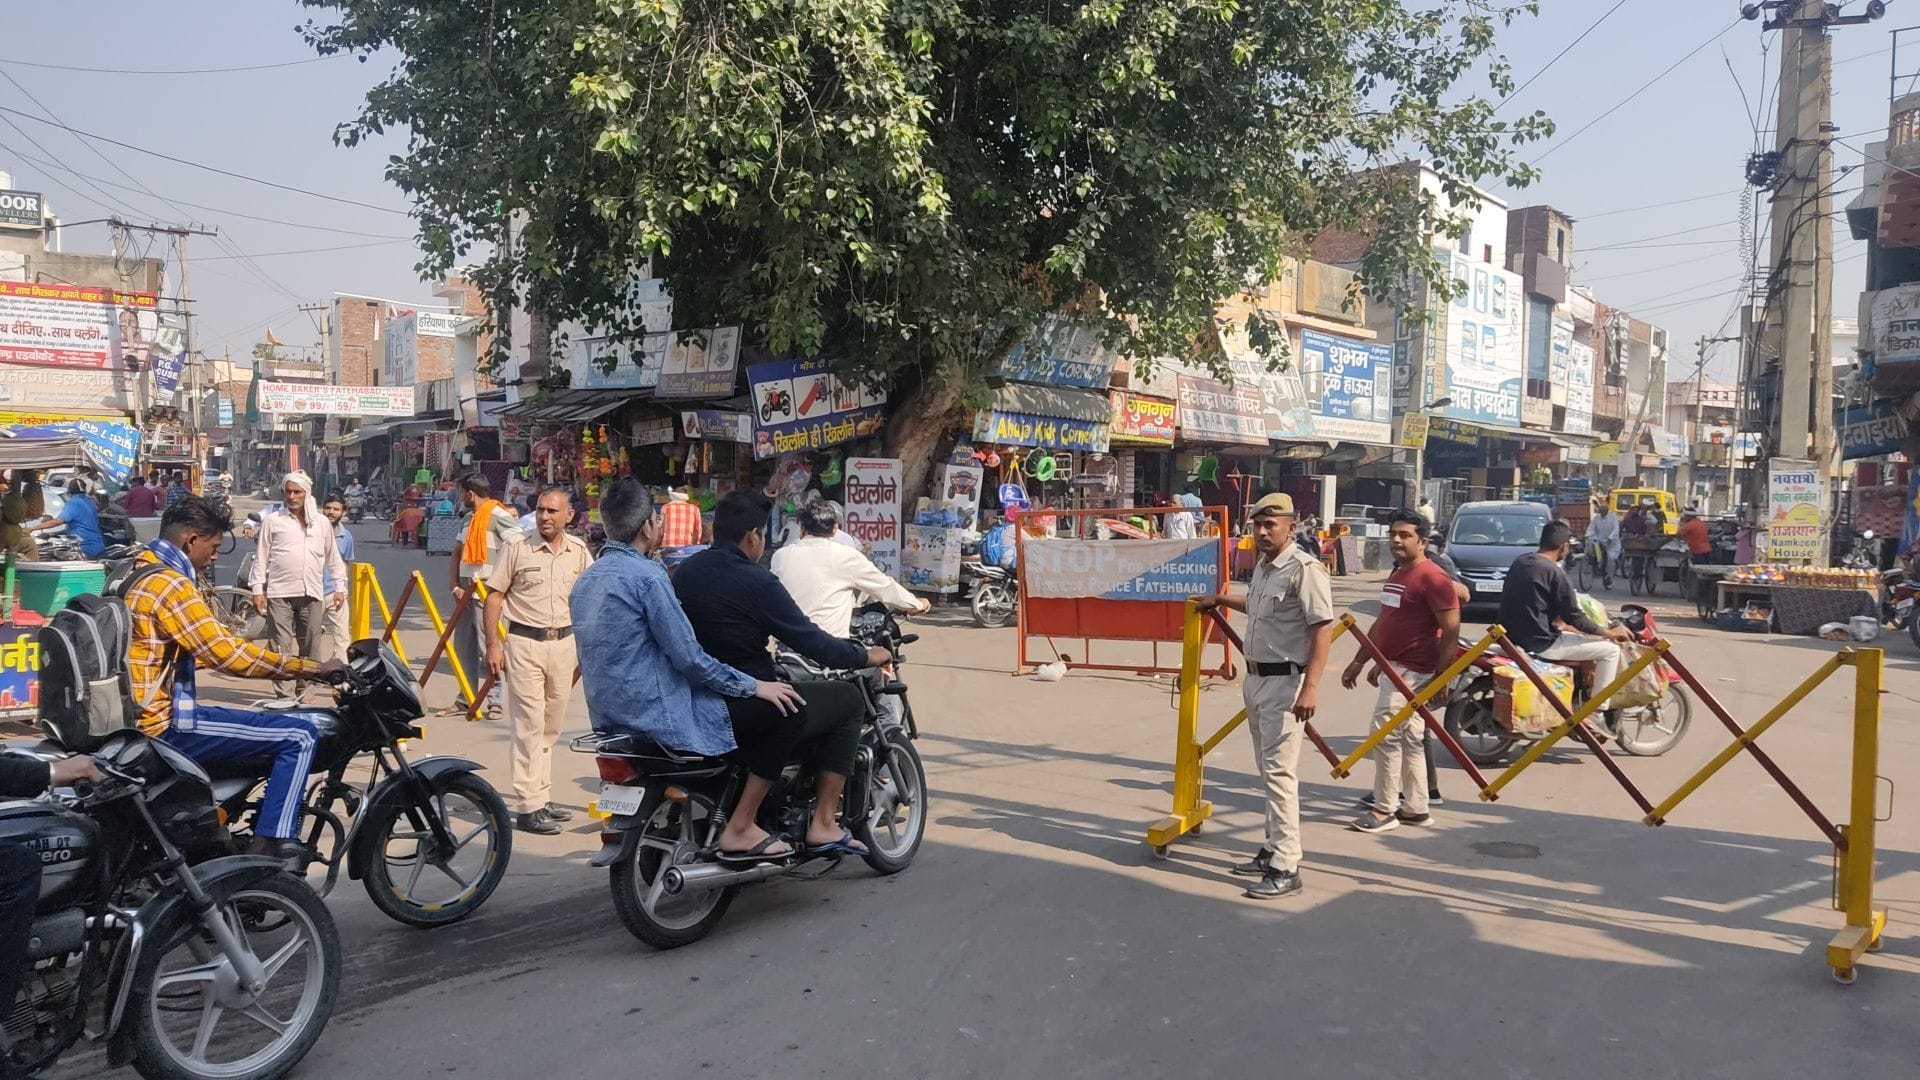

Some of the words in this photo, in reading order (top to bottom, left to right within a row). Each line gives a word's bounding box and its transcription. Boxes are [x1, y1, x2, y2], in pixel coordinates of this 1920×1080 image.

[418, 313, 446, 329] हरियाणा
[1329, 346, 1369, 373] शुभम
[262, 383, 289, 393] HOME
[291, 385, 328, 393] BAKER'S
[1127, 400, 1175, 426] गुनगुन
[773, 427, 808, 453] खिलौने
[810, 424, 822, 448] ही
[823, 418, 856, 444] खिलौने
[995, 416, 1031, 442] Ahuja
[1035, 420, 1057, 445] Kids
[1060, 423, 1094, 445] Corner
[847, 474, 897, 505] खिलौने
[847, 511, 897, 541] खिलौने
[1771, 539, 1817, 547] Namkeen
[1774, 548, 1814, 558] House
[1150, 562, 1217, 575] CHECKING
[1135, 577, 1207, 594] FATEHBAAD
[36, 848, 71, 863] ero
